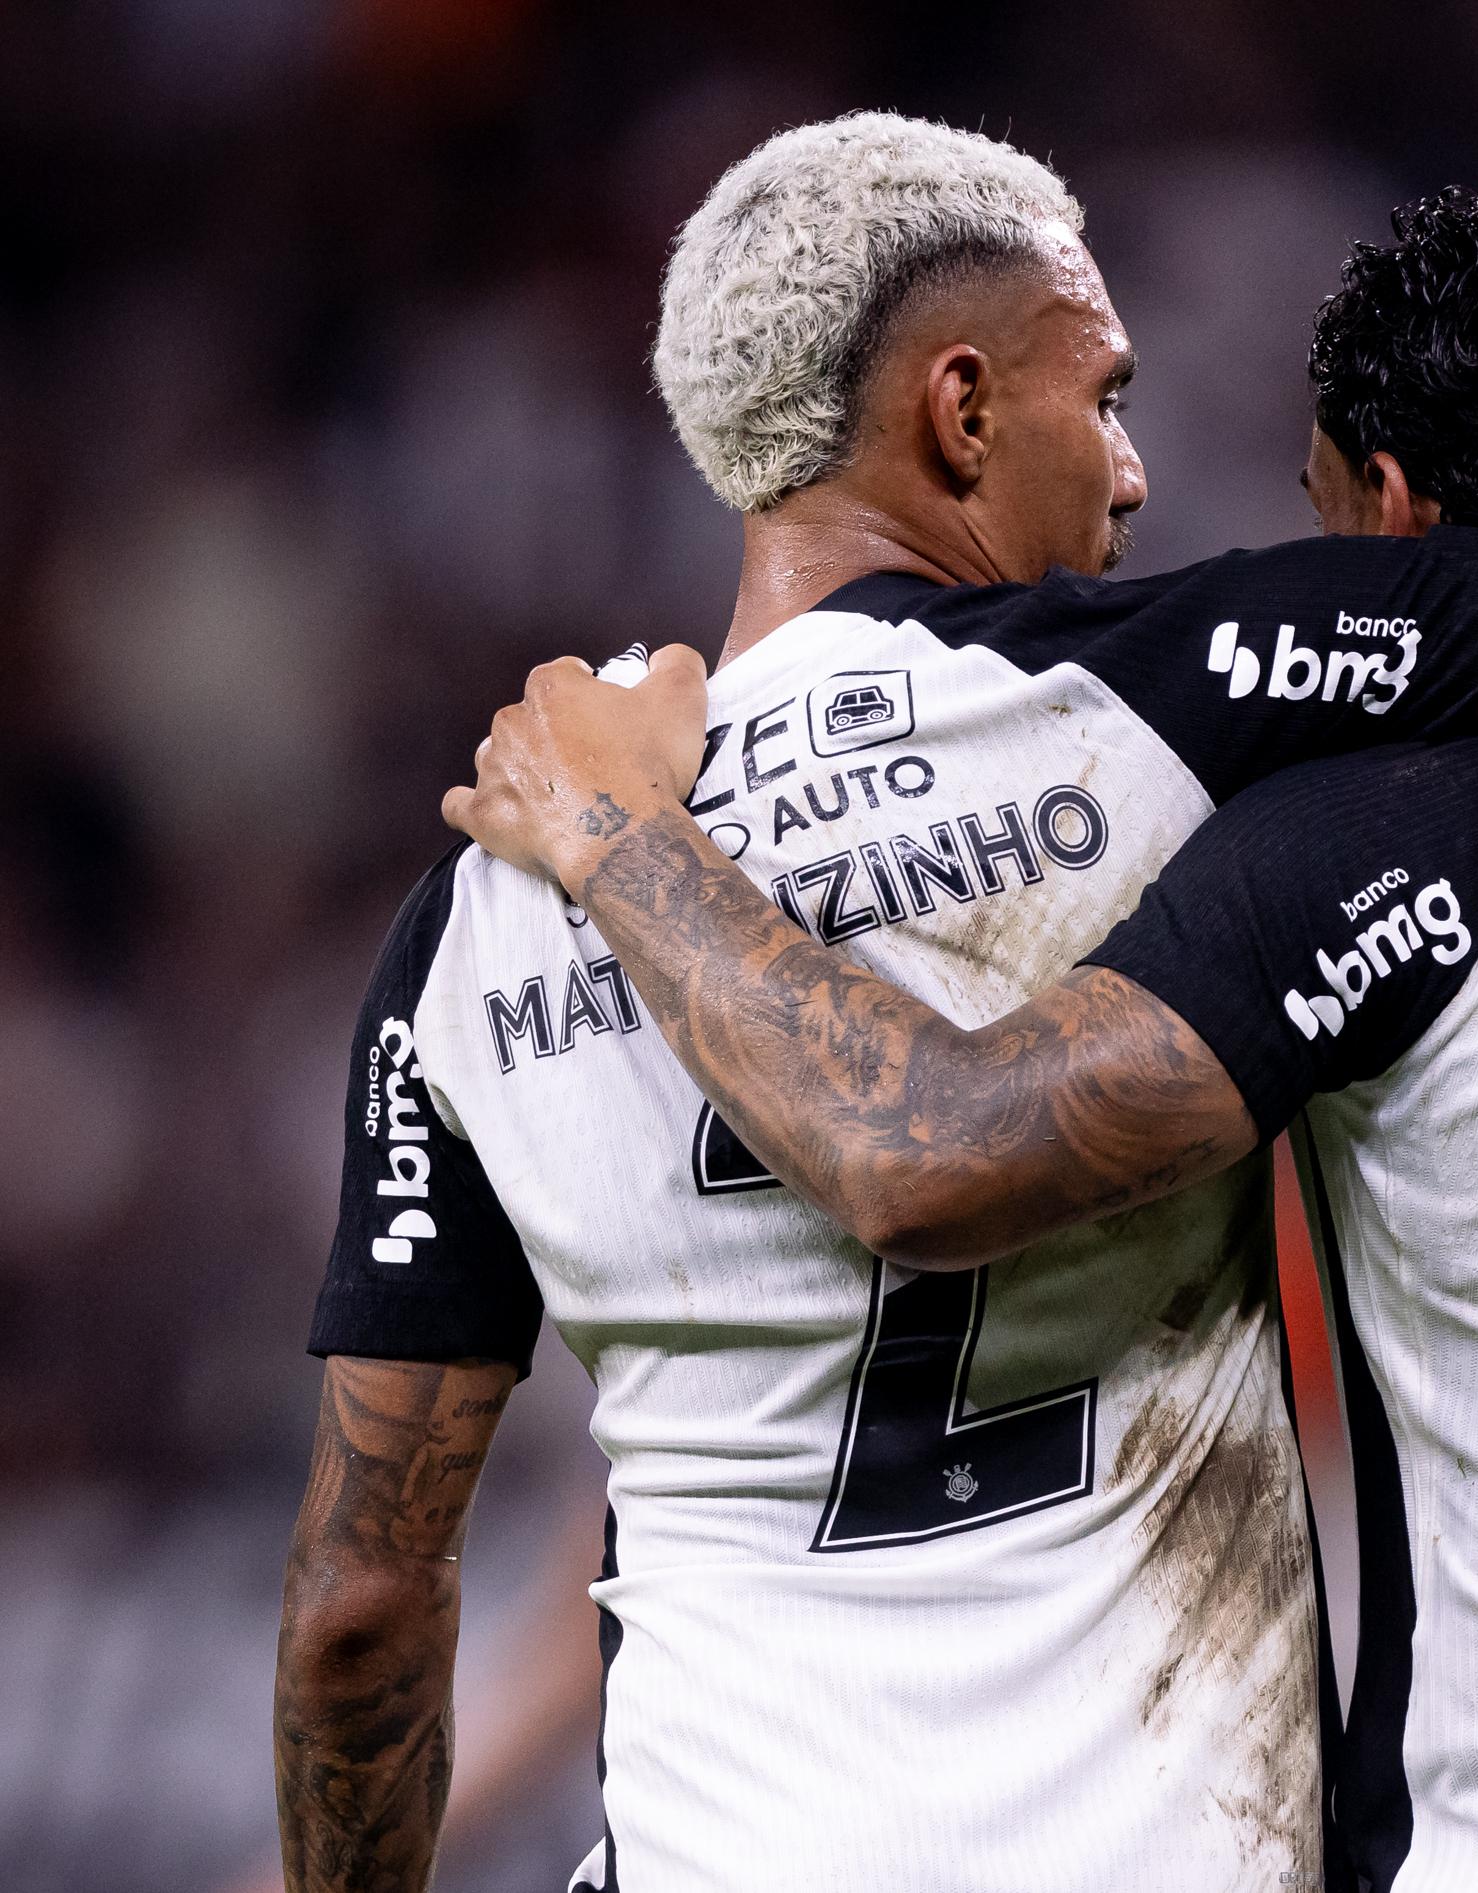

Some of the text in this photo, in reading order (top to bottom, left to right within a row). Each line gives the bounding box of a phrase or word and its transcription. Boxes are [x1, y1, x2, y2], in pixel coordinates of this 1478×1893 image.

[773, 755, 936, 847] AUTO
[1316, 878, 1472, 1011] bmg
[1340, 868, 1410, 922] banco
[692, 1099, 1100, 1553] 2
